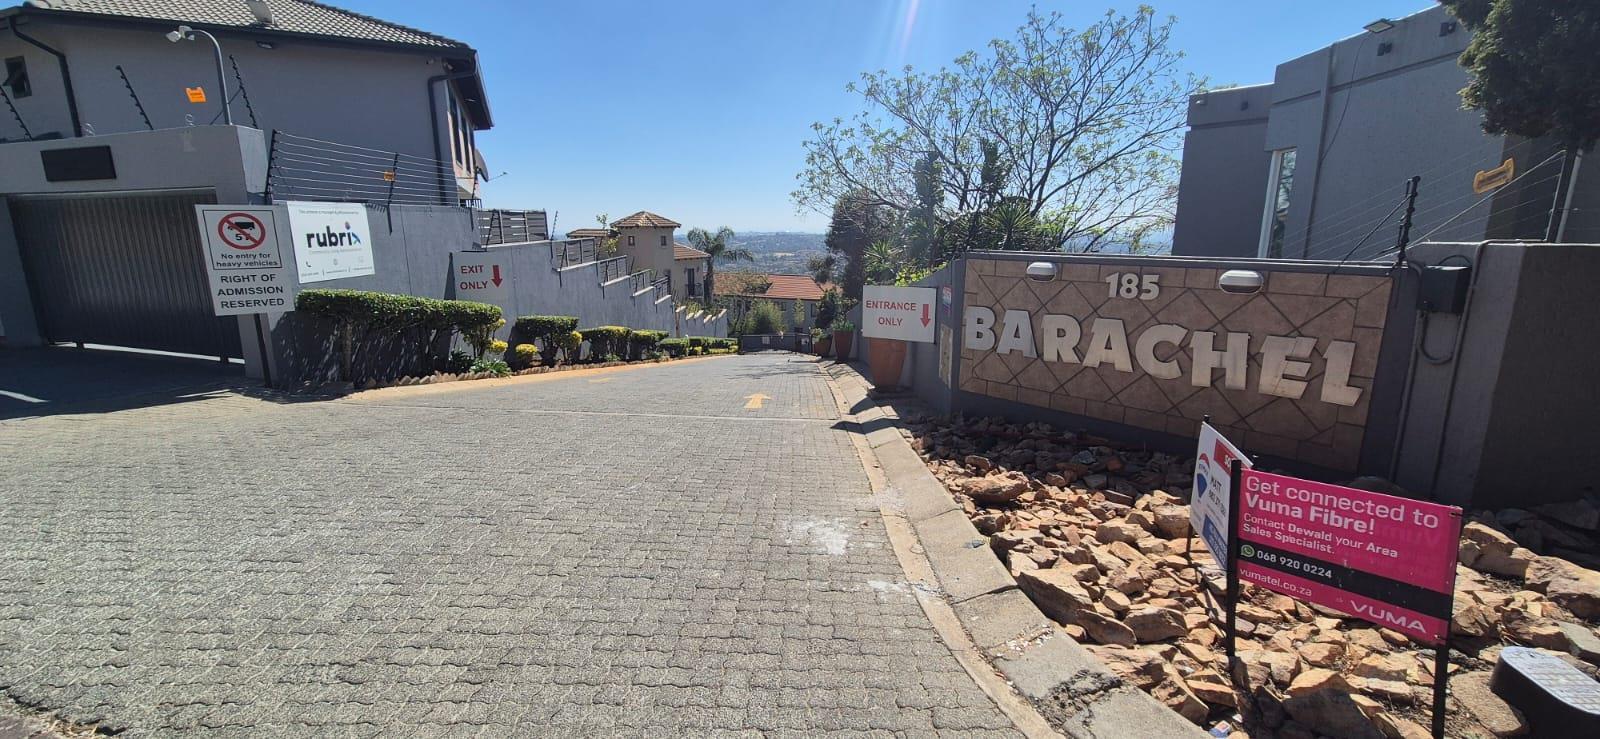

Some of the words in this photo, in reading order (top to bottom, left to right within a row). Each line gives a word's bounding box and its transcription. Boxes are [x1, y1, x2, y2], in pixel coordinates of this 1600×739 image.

[220, 274, 257, 283] RIGHT
[261, 273, 277, 282] OF
[460, 264, 484, 274] EXIT
[217, 286, 284, 297] ADMISSION
[460, 281, 488, 290] ONLY
[1105, 271, 1161, 301] 185
[221, 298, 285, 309] RESERVED
[865, 300, 917, 311] ENTRANCE
[878, 317, 903, 326] ONLY
[964, 305, 1364, 407] BARACHEL
[1245, 492, 1303, 519] Vuma
[1309, 505, 1375, 535] Fibre!
[1246, 476, 1280, 496] Get
[1286, 487, 1405, 522] connected
[1412, 508, 1439, 529] to
[1243, 512, 1285, 531] Contact
[1288, 523, 1332, 541] Dewald
[1335, 536, 1363, 549] your
[1366, 542, 1398, 558] Area
[1243, 523, 1272, 538] Sales
[1275, 531, 1335, 554] Specialist.
[1257, 550, 1277, 563] 068
[1279, 556, 1300, 569] 920
[1303, 563, 1332, 578] 0224
[1240, 568, 1312, 597] vumatel.co.za
[1350, 599, 1426, 634] VUMA
